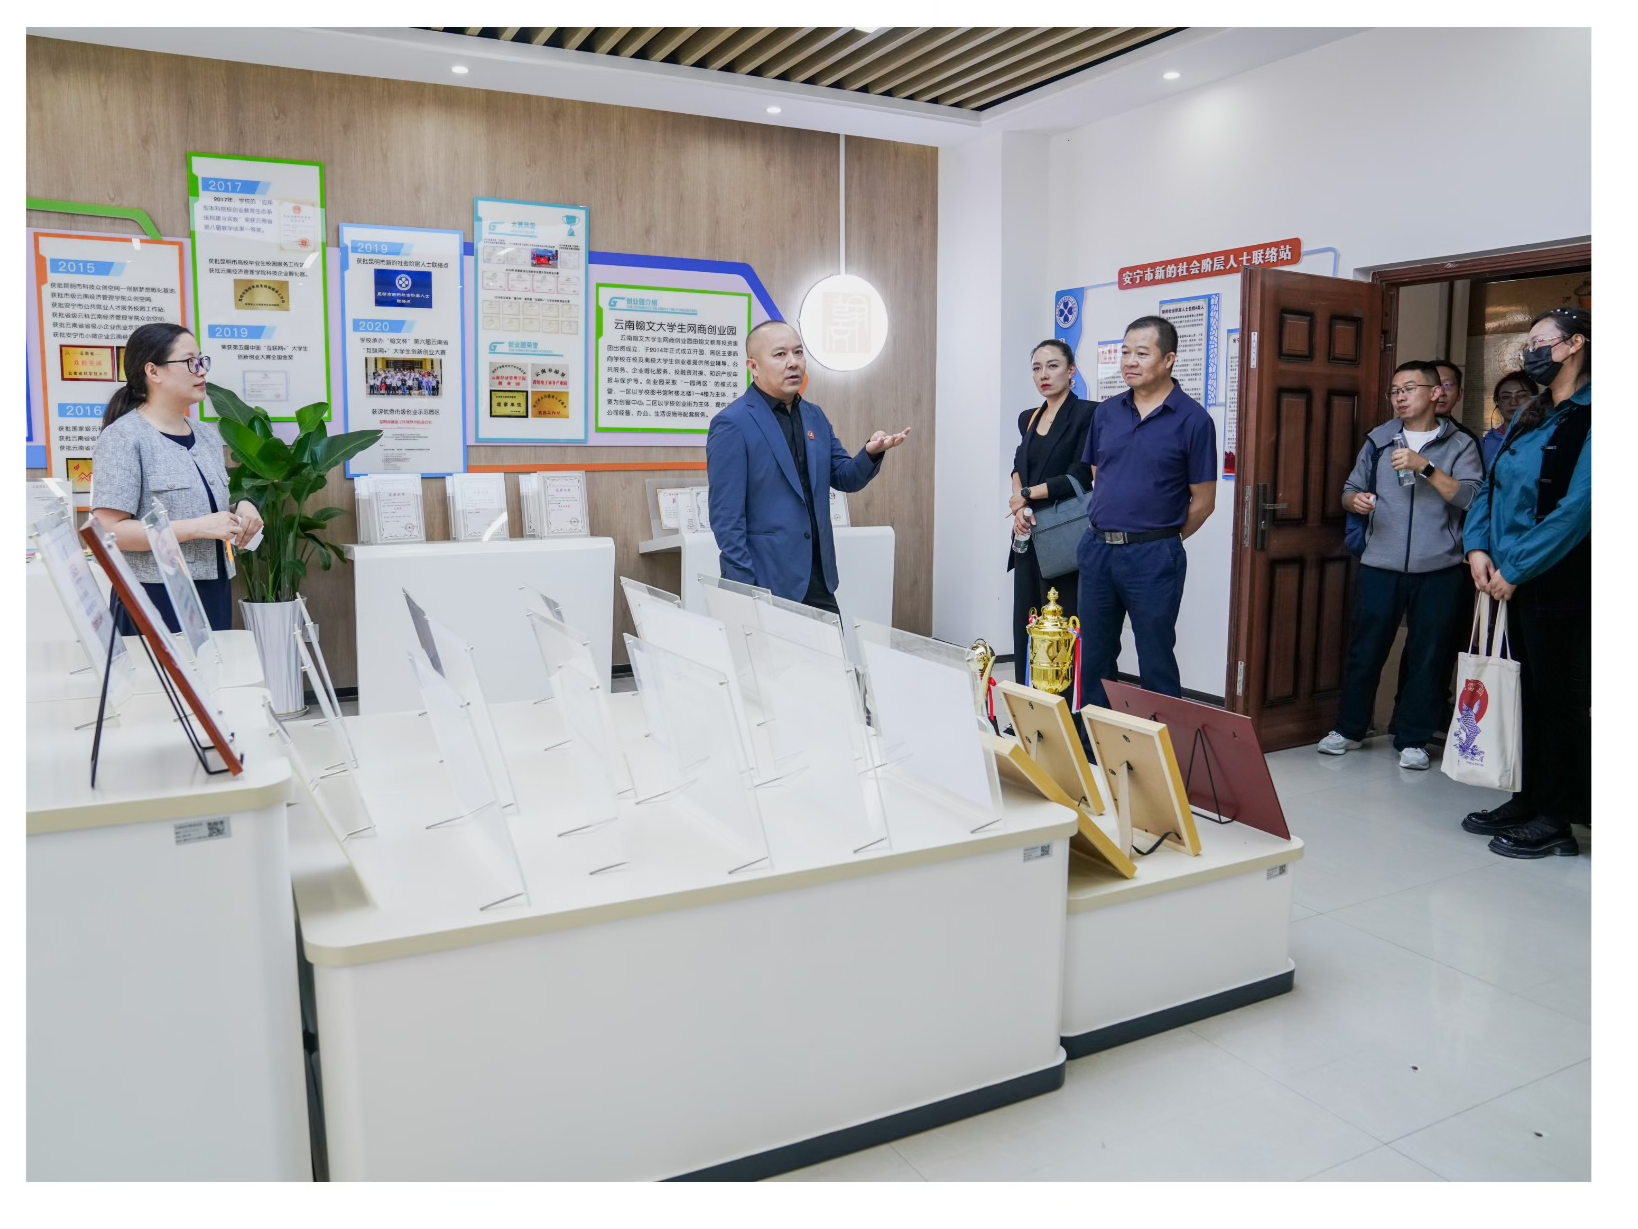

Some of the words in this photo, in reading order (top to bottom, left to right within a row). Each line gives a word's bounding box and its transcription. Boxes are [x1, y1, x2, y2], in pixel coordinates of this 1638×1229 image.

[208, 180, 243, 192] 2017
[357, 242, 388, 253] 2019
[58, 261, 95, 273] 2015
[1122, 244, 1293, 288] 安宁市新的社会阶层人士联络站
[358, 321, 390, 331] 2020
[614, 318, 737, 336] 云南翰文大学生网商创业园
[215, 327, 249, 338] 2019
[65, 405, 102, 416] 2016
